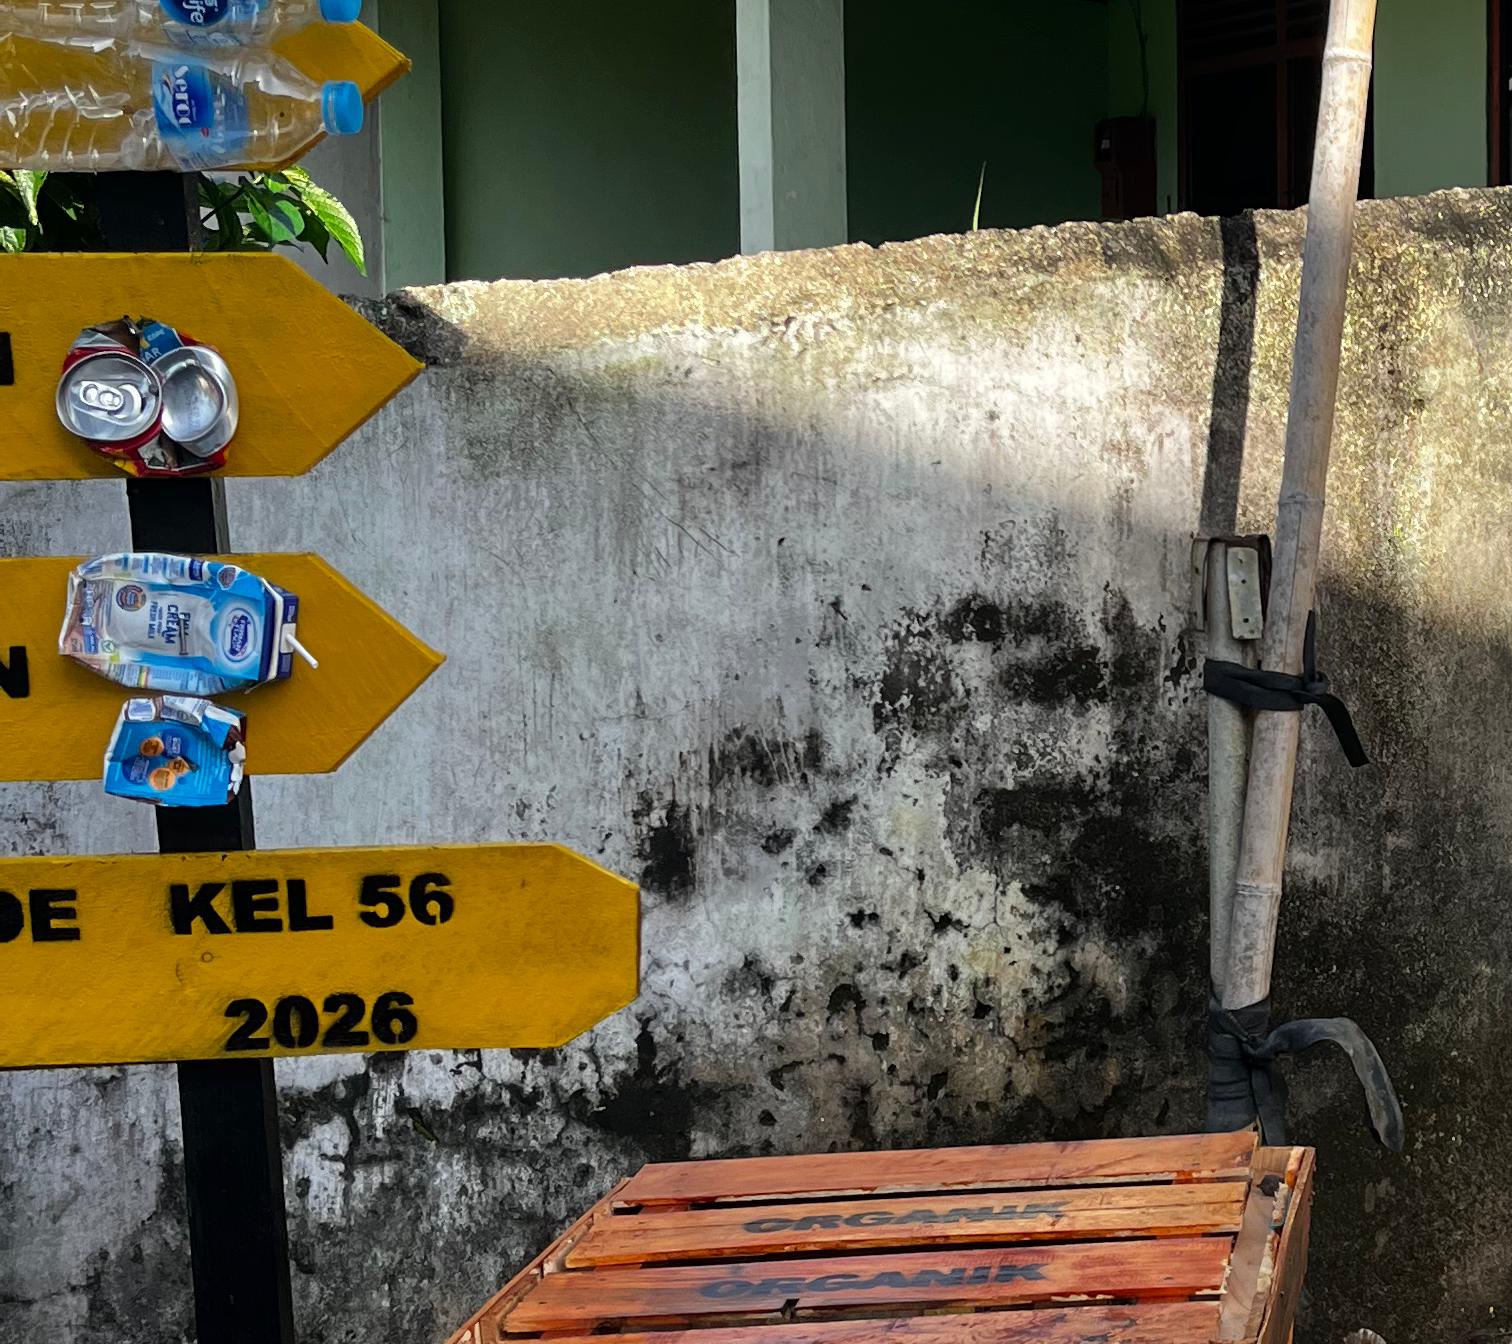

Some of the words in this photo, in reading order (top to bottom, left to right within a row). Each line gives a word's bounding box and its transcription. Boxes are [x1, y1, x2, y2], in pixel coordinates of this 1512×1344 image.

[168, 879, 333, 936] KEL
[358, 872, 455, 928] 56
[223, 991, 419, 1052] 2026
